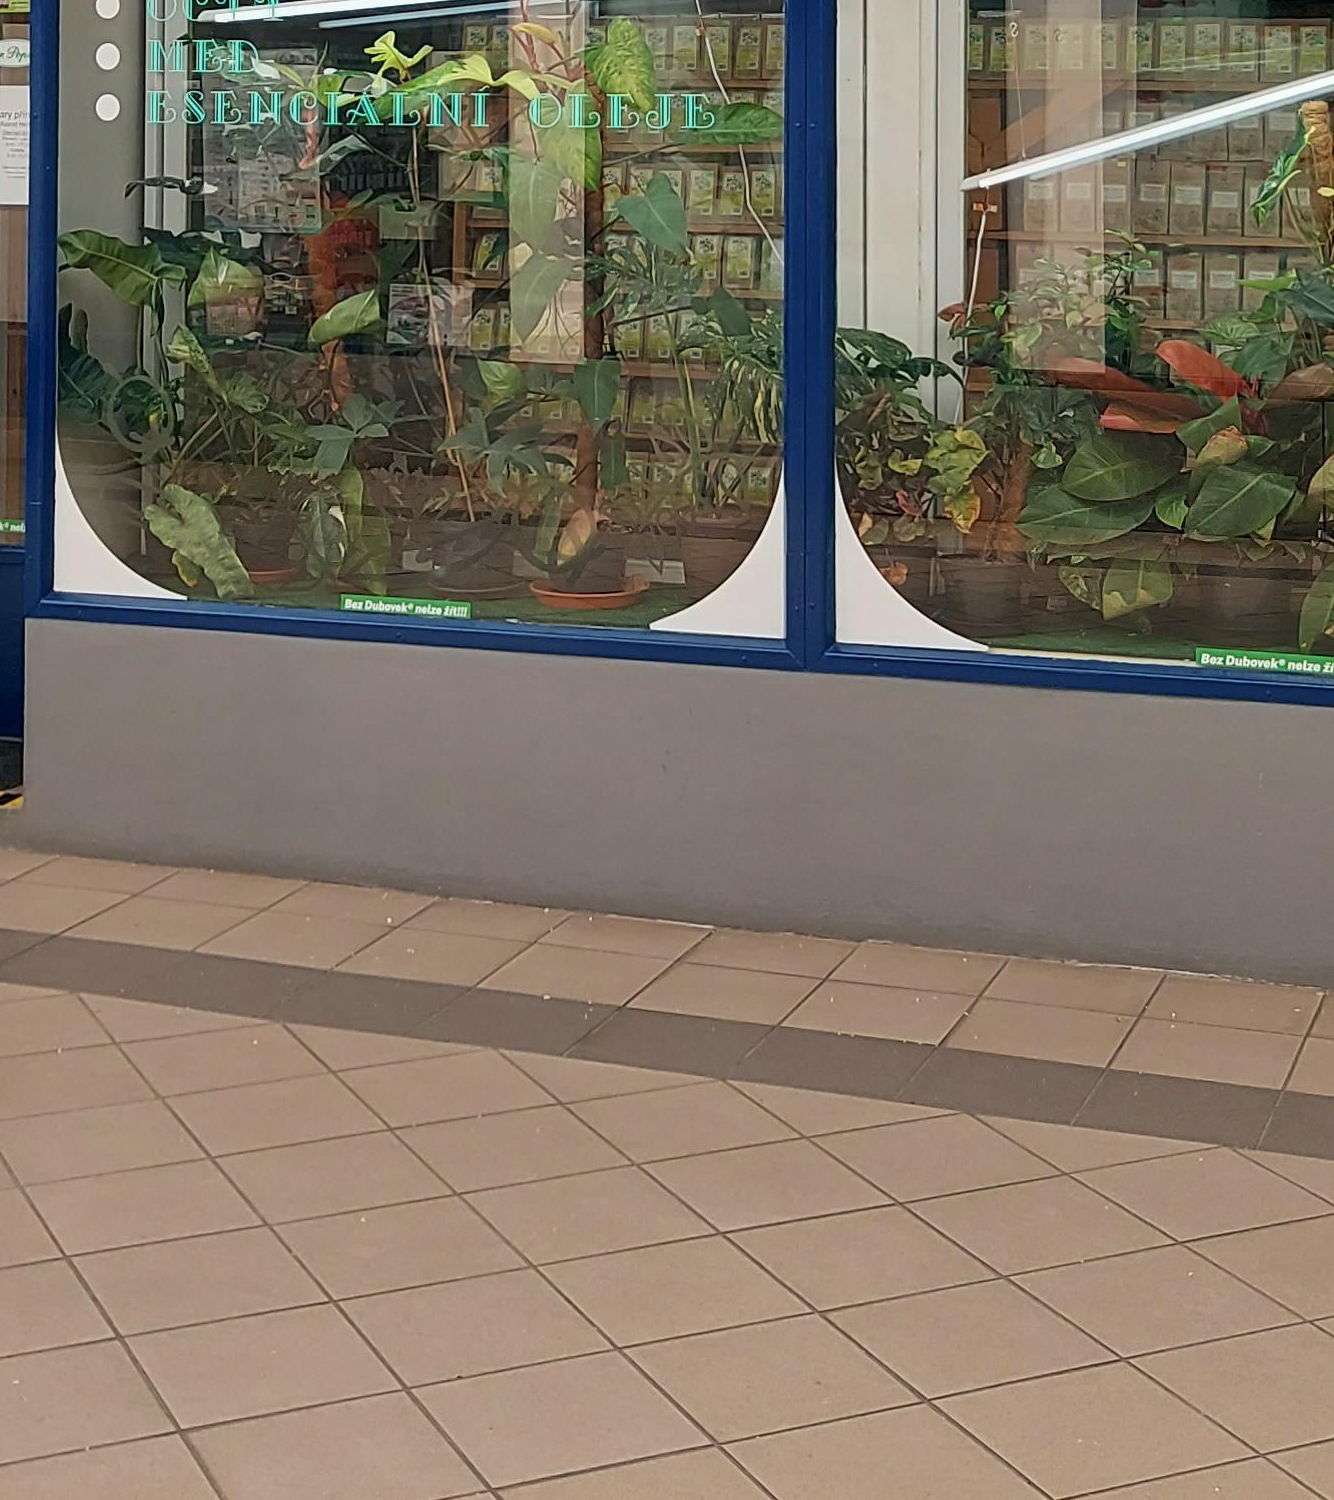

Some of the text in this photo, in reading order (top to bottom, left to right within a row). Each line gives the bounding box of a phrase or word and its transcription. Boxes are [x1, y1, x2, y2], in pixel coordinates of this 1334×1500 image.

[146, 39, 259, 73] MED
[146, 85, 715, 129] ESENCIÁLNÍ OLEJE
[344, 598, 364, 610] Bez
[415, 604, 443, 616] nelze
[1201, 653, 1224, 665] Bez
[1287, 661, 1321, 673] nelze
